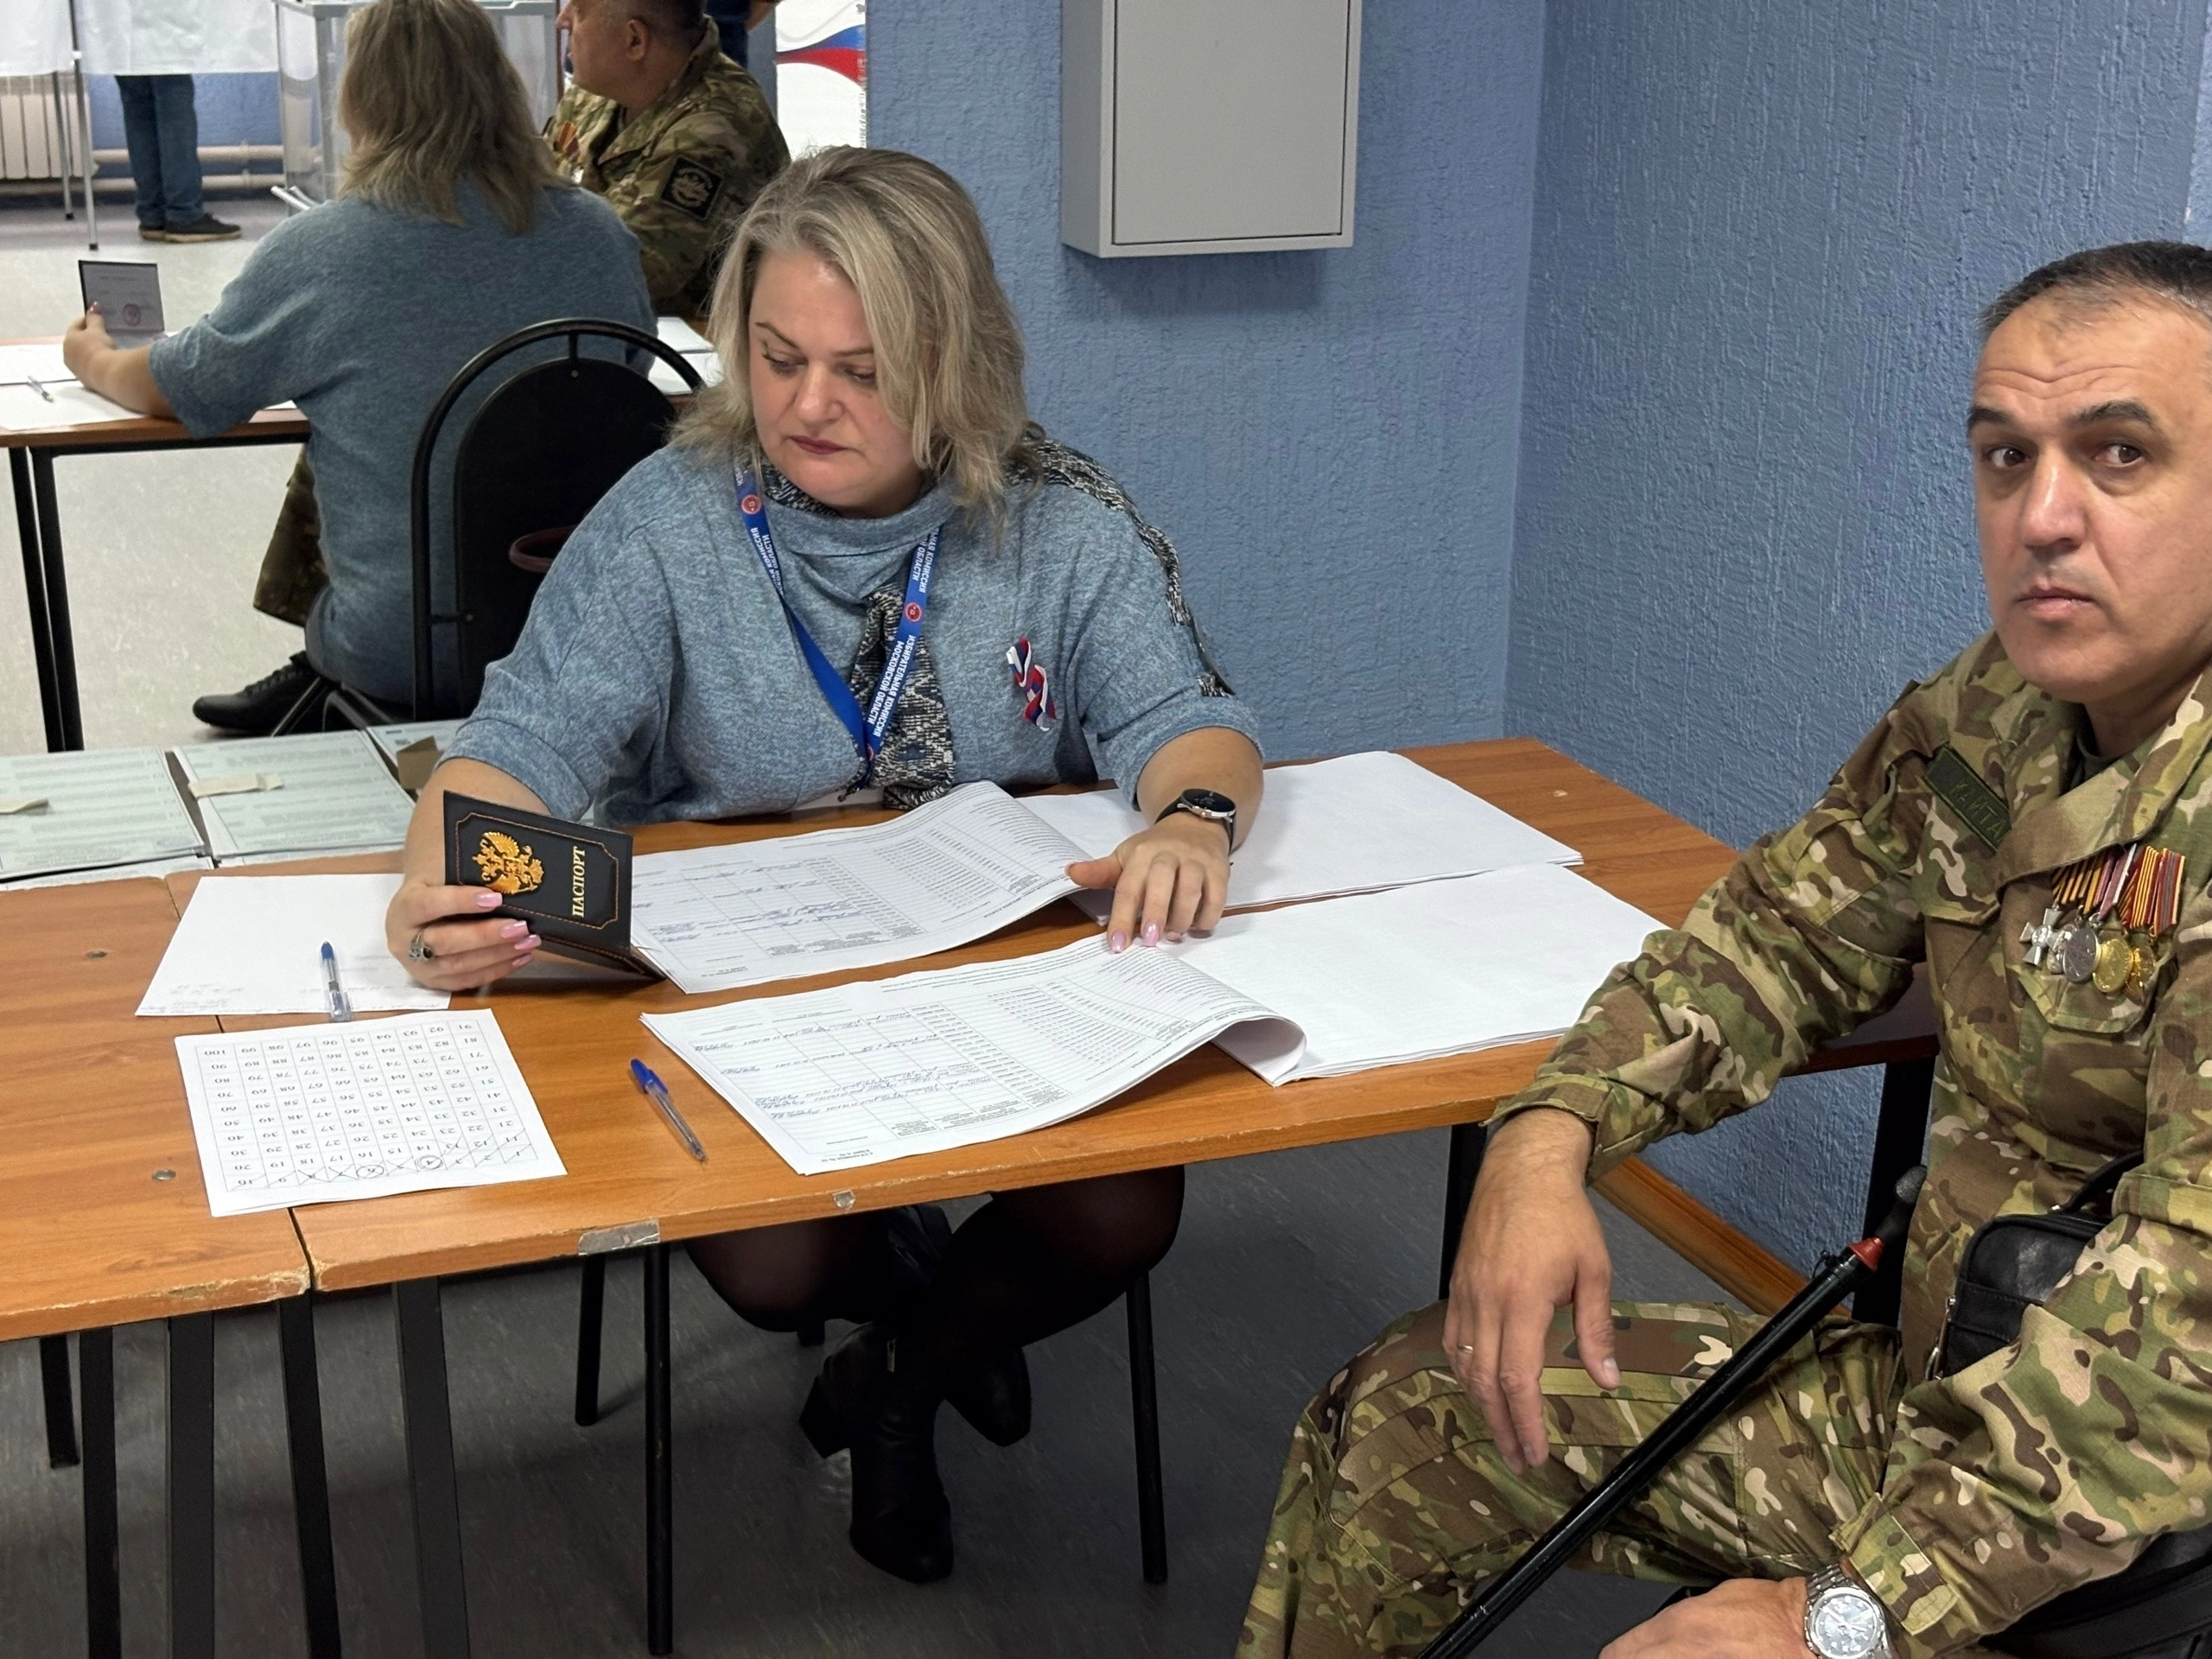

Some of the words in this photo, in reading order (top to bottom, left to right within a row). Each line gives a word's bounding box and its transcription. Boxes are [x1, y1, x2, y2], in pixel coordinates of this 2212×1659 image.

[750, 527, 773, 571] КОМИССИЯ
[761, 534, 779, 568] ОБЛАСТИ
[912, 546, 925, 582] ОБЛАСТИ
[918, 550, 934, 594] КОМИССИЯ
[879, 639, 905, 692] МОСКОВСКОЙ
[888, 634, 916, 696] ИЗБИРАТЕЛЬНАЯ
[867, 691, 886, 726] ОБЛАСТИ
[872, 695, 895, 738] КОМИССИЯ
[572, 845, 586, 918] ПАСПОРТ
